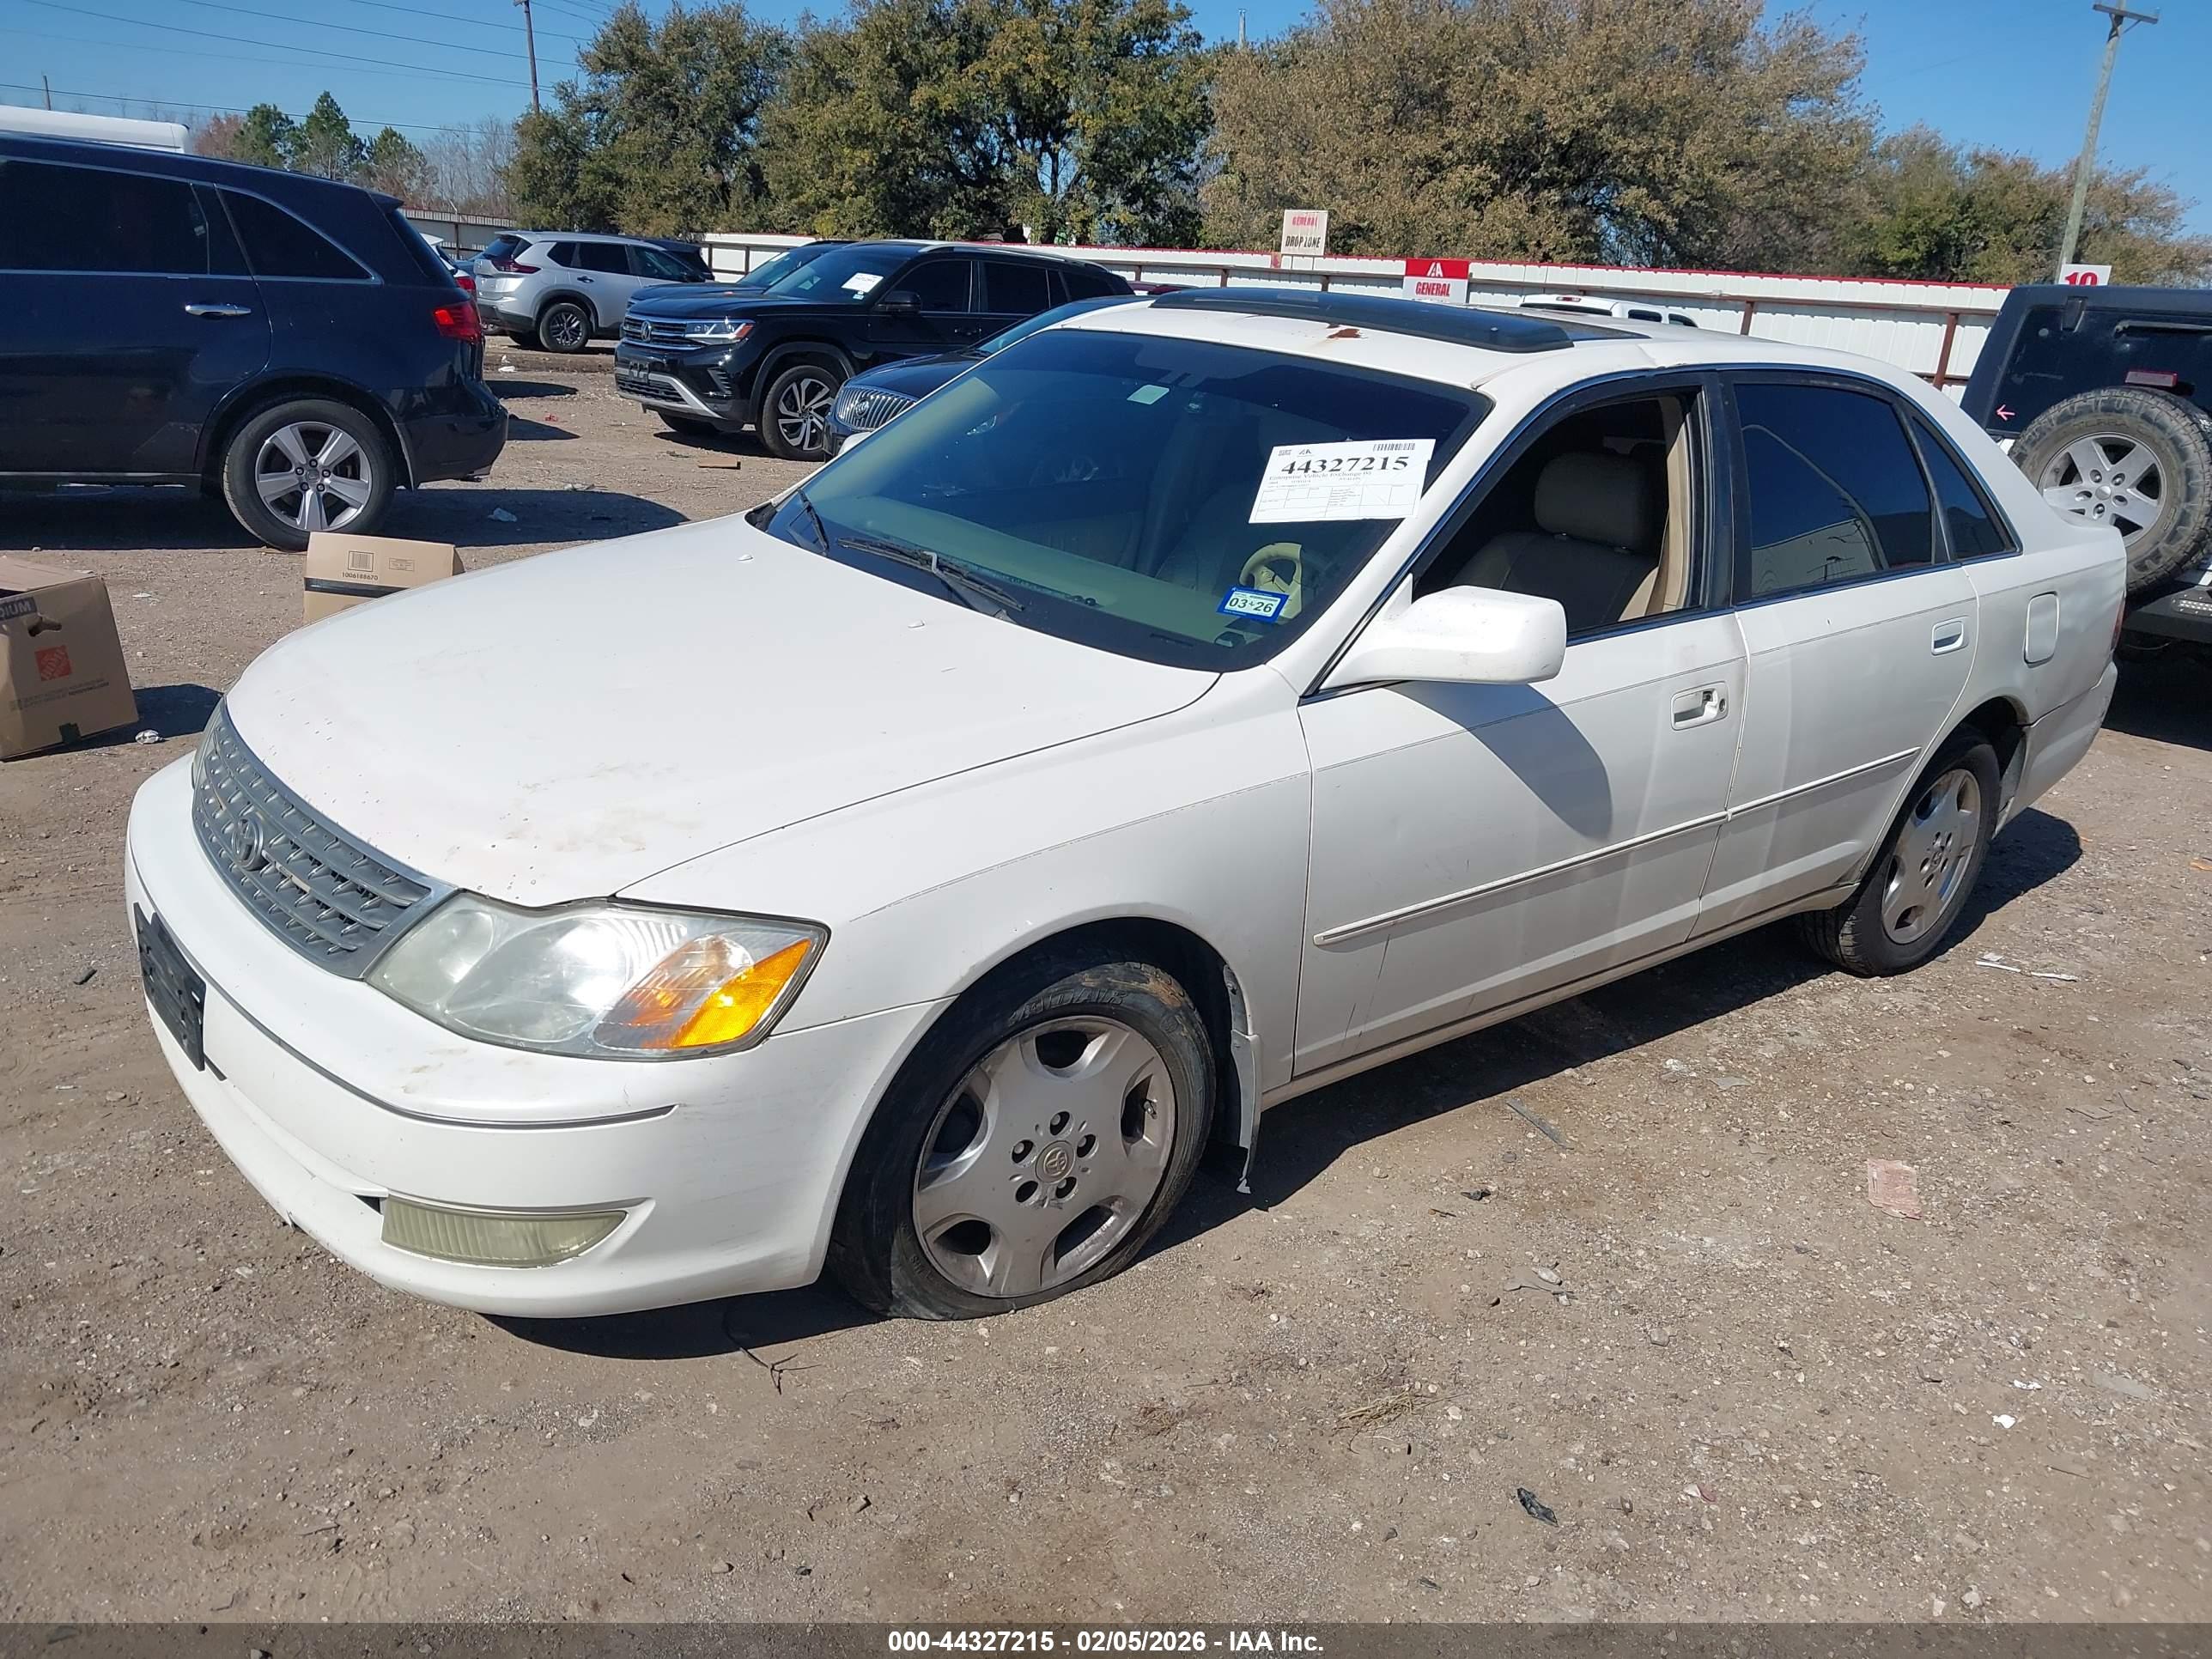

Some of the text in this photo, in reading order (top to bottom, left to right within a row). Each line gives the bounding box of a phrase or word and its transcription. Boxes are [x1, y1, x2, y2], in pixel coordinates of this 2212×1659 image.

[1285, 235, 1321, 248] DROP ZONE
[1415, 282, 1451, 296] GENERAL
[1281, 456, 1409, 475] 44327215
